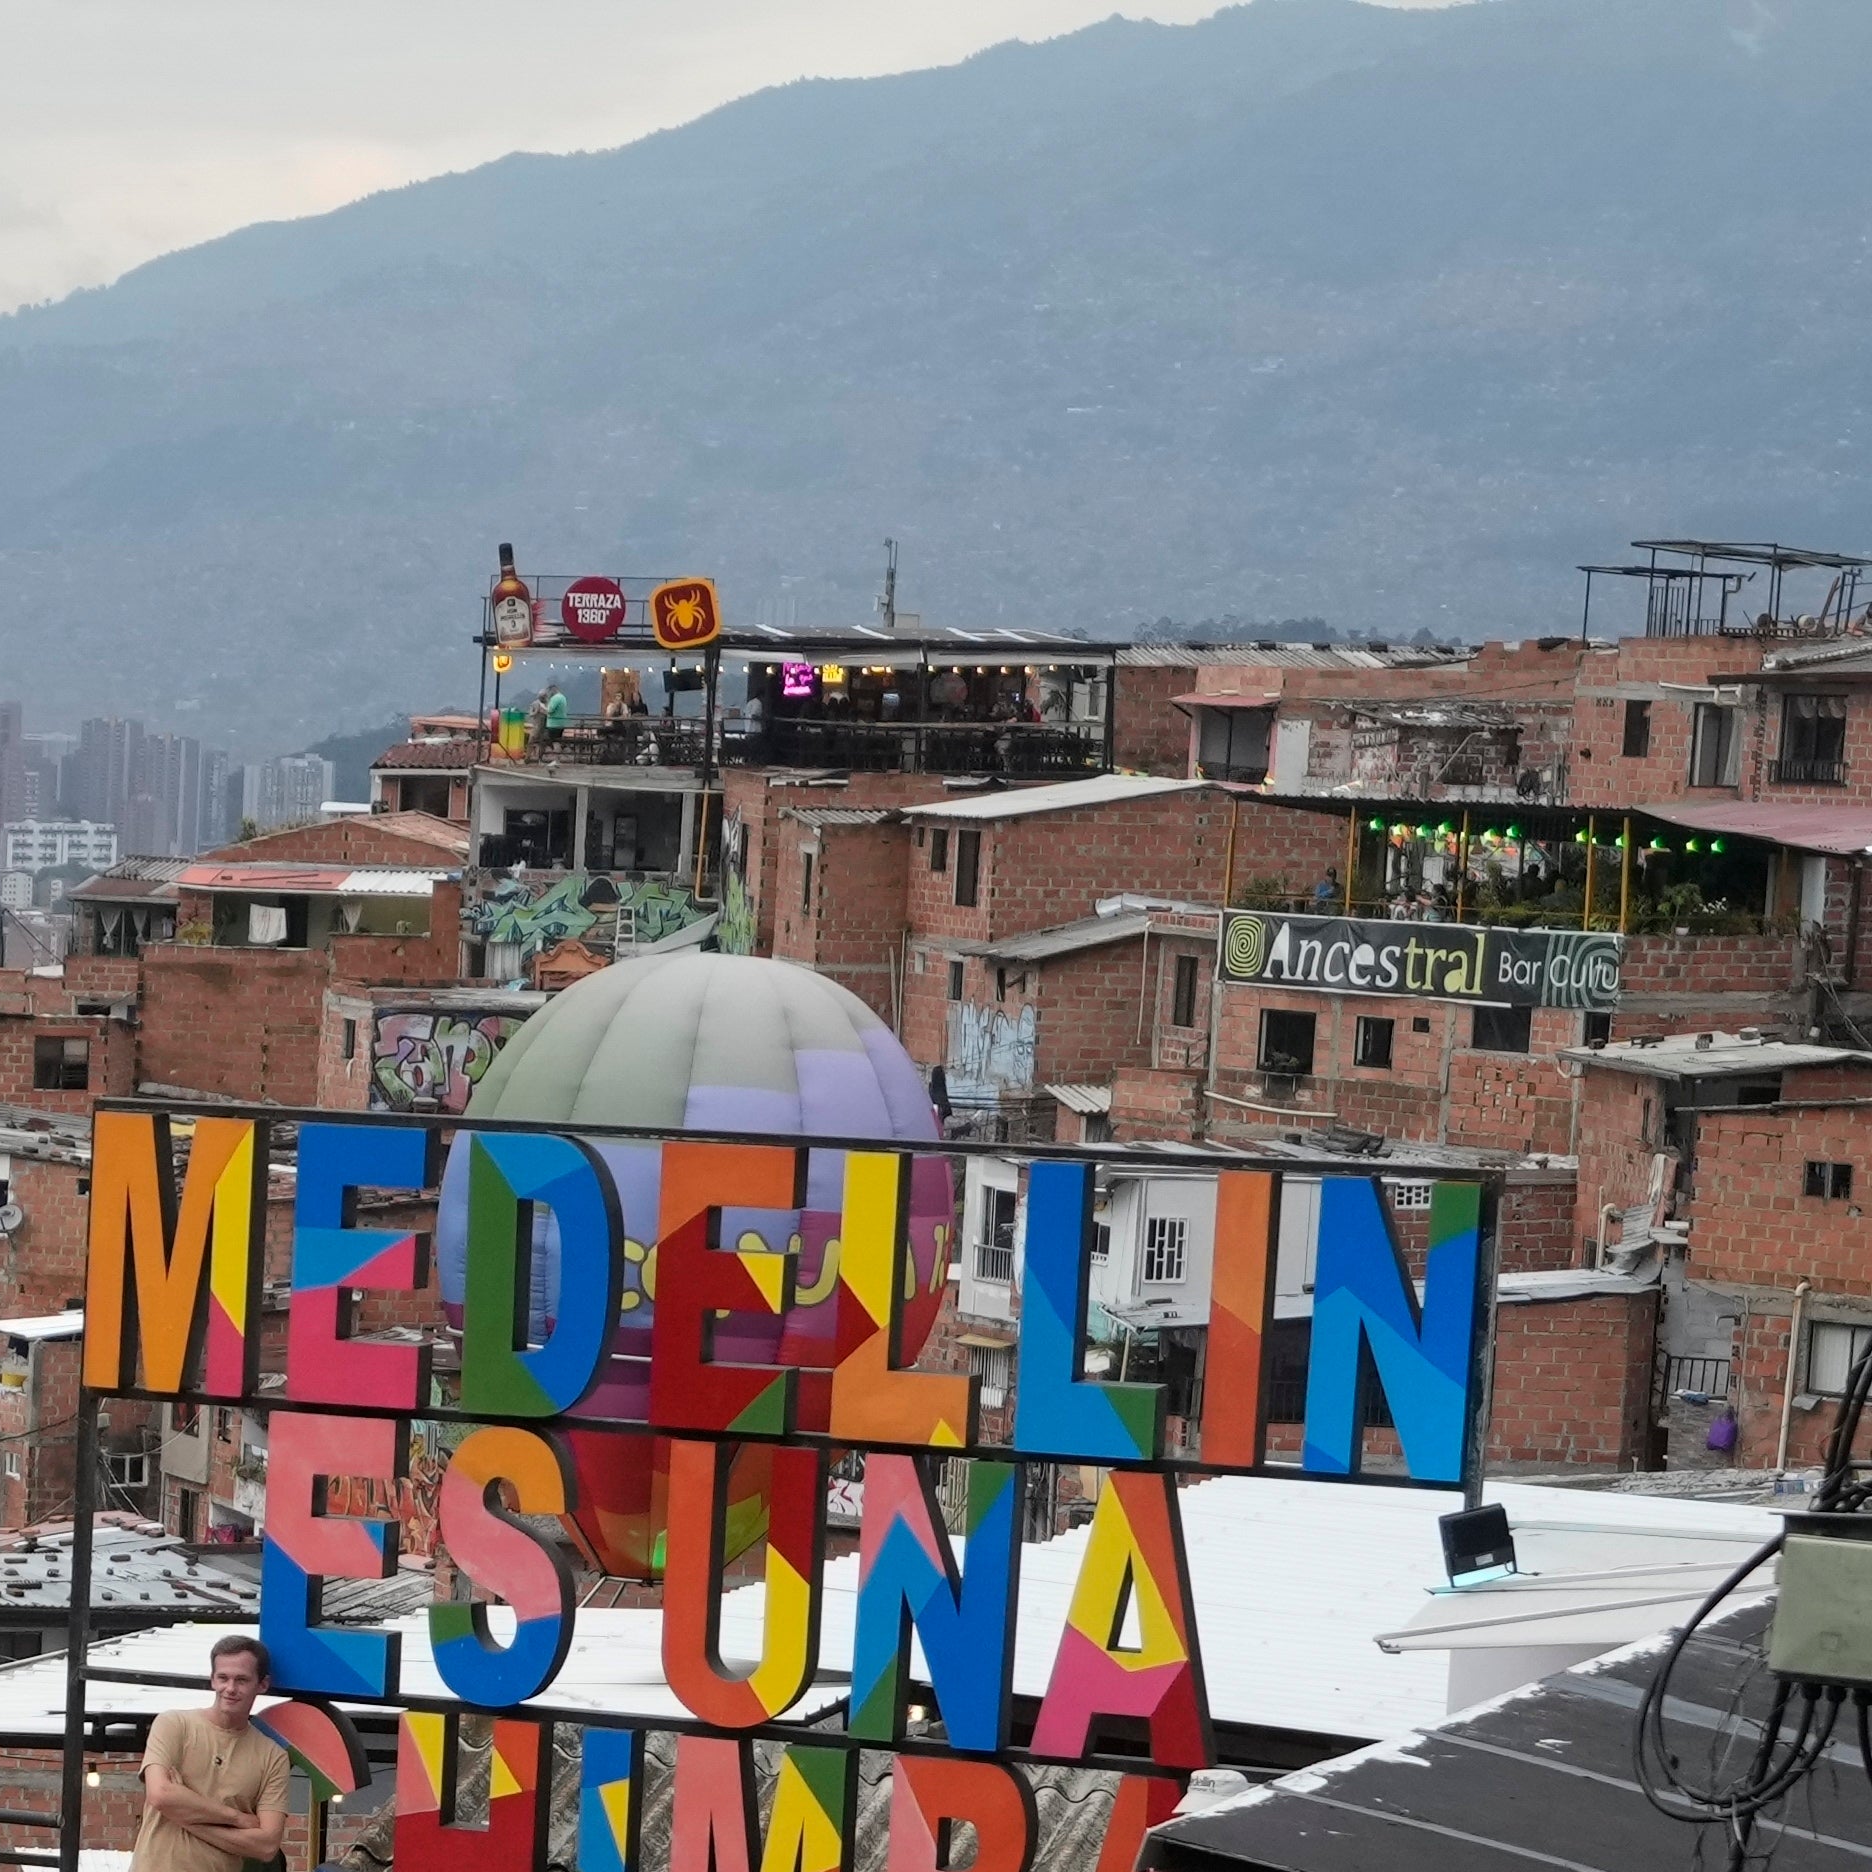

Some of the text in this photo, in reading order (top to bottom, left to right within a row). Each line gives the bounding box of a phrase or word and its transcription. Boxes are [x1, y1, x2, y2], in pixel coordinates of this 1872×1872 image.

[567, 592, 622, 610] TERRAZA
[1261, 921, 1488, 996] Ancestral
[1498, 950, 1542, 986] Bar
[82, 1110, 1484, 1482] MEDELLIN
